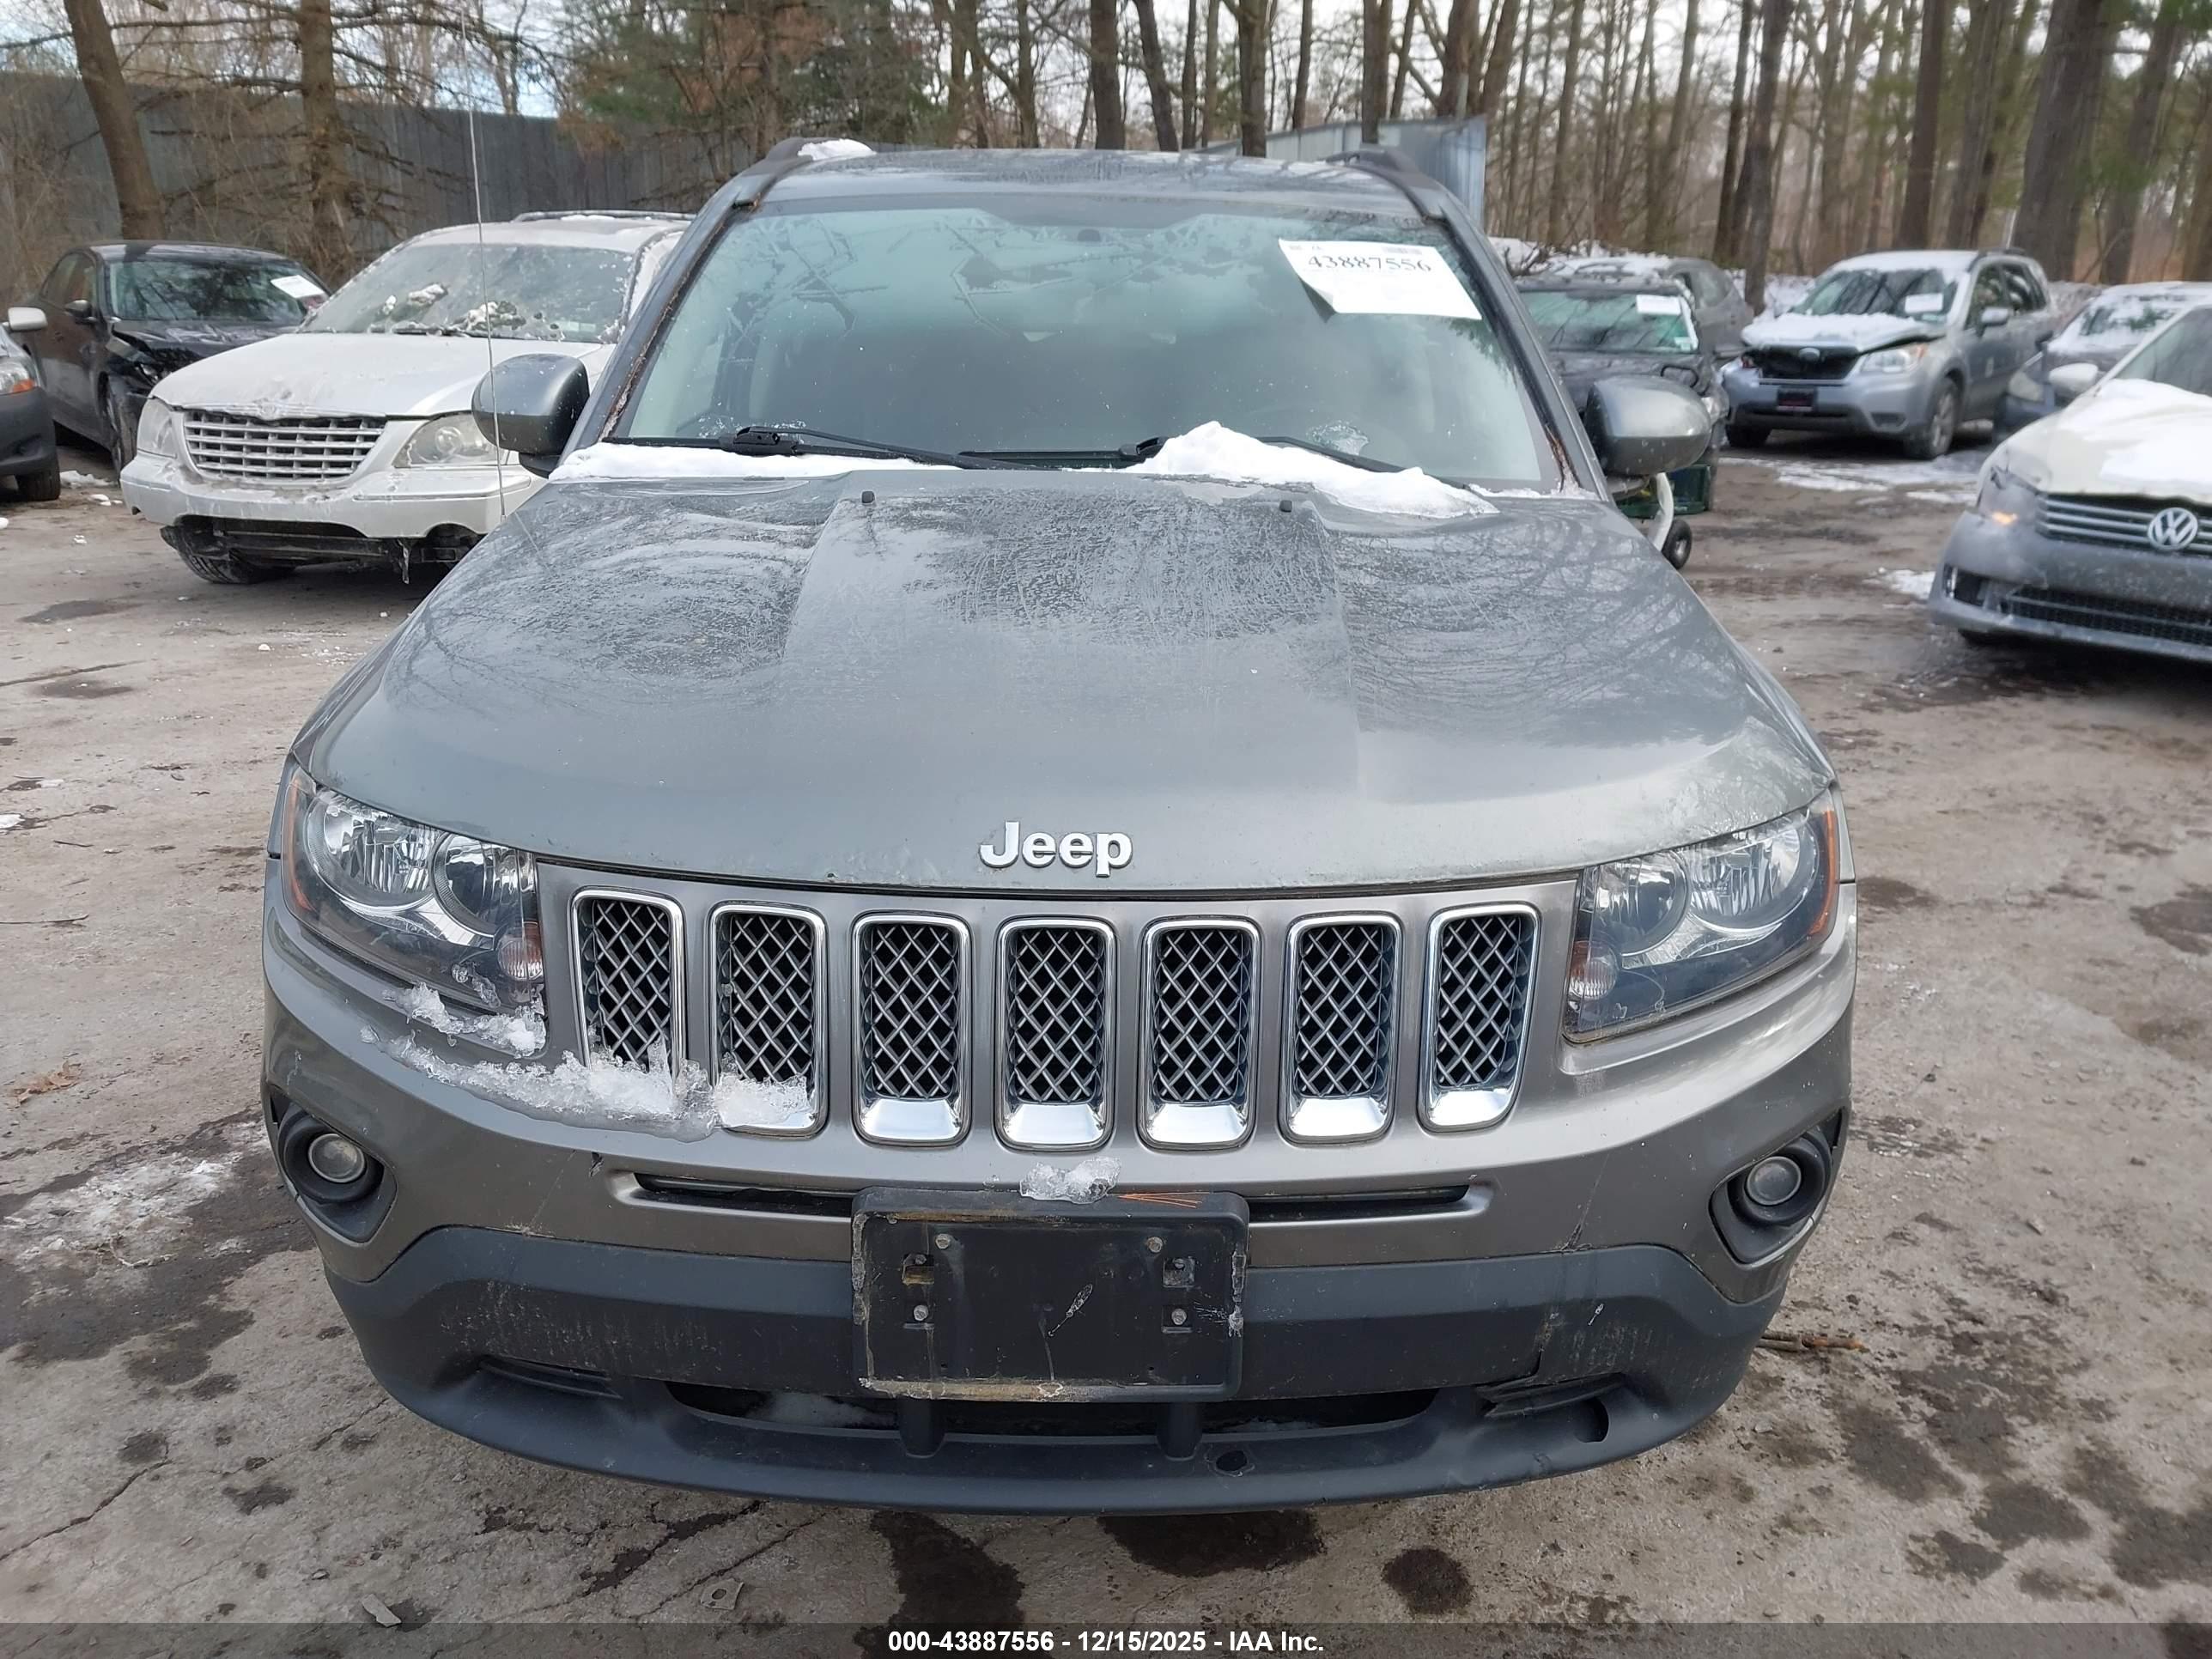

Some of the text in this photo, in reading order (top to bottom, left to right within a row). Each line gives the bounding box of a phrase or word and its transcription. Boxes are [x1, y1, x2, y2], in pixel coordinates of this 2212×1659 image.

[1308, 254, 1432, 272] 43887556
[2149, 508, 2197, 550] VW
[979, 821, 1133, 878] Jeep
